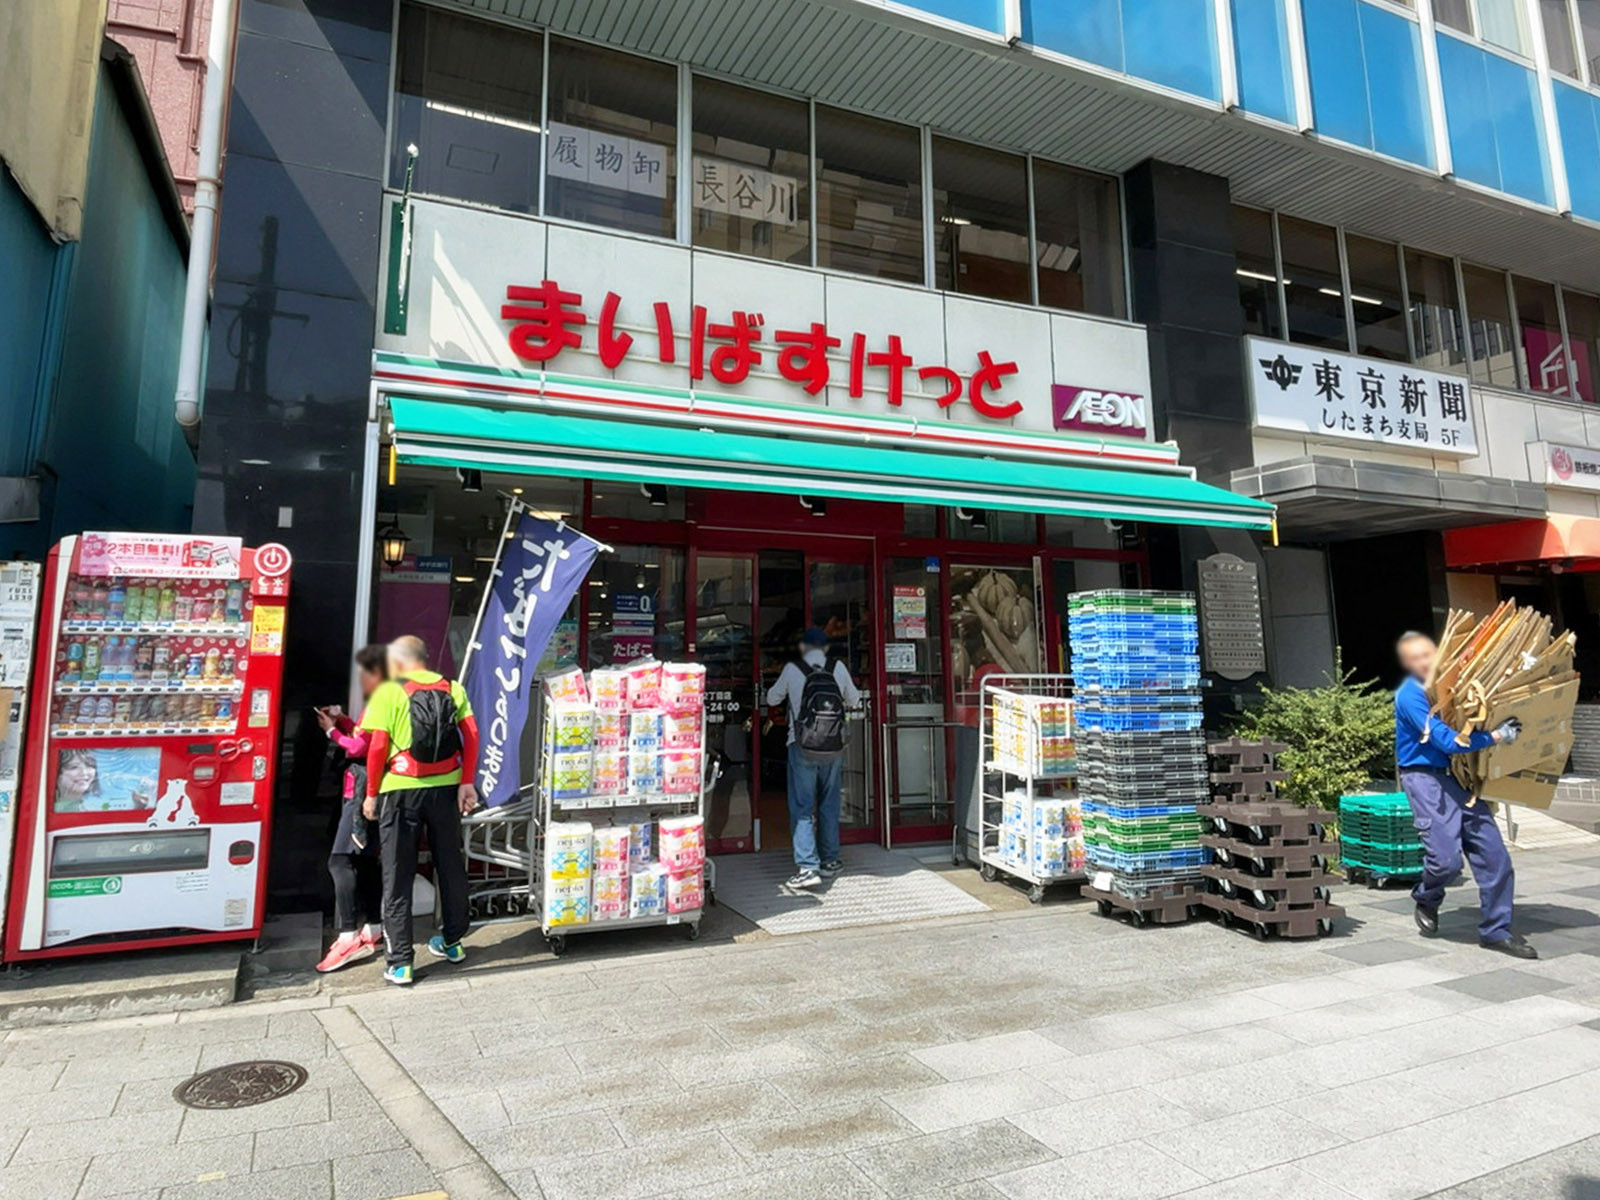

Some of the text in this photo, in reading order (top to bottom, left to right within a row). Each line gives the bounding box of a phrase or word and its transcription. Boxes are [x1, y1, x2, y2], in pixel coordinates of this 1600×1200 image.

[551, 135, 660, 183] 履物卸
[696, 165, 796, 223] 長谷川
[500, 280, 1023, 420] まいばすけっと
[1312, 357, 1467, 422] 東京新聞
[1321, 407, 1461, 447] したまち支局 5F
[613, 643, 652, 657] たばこ
